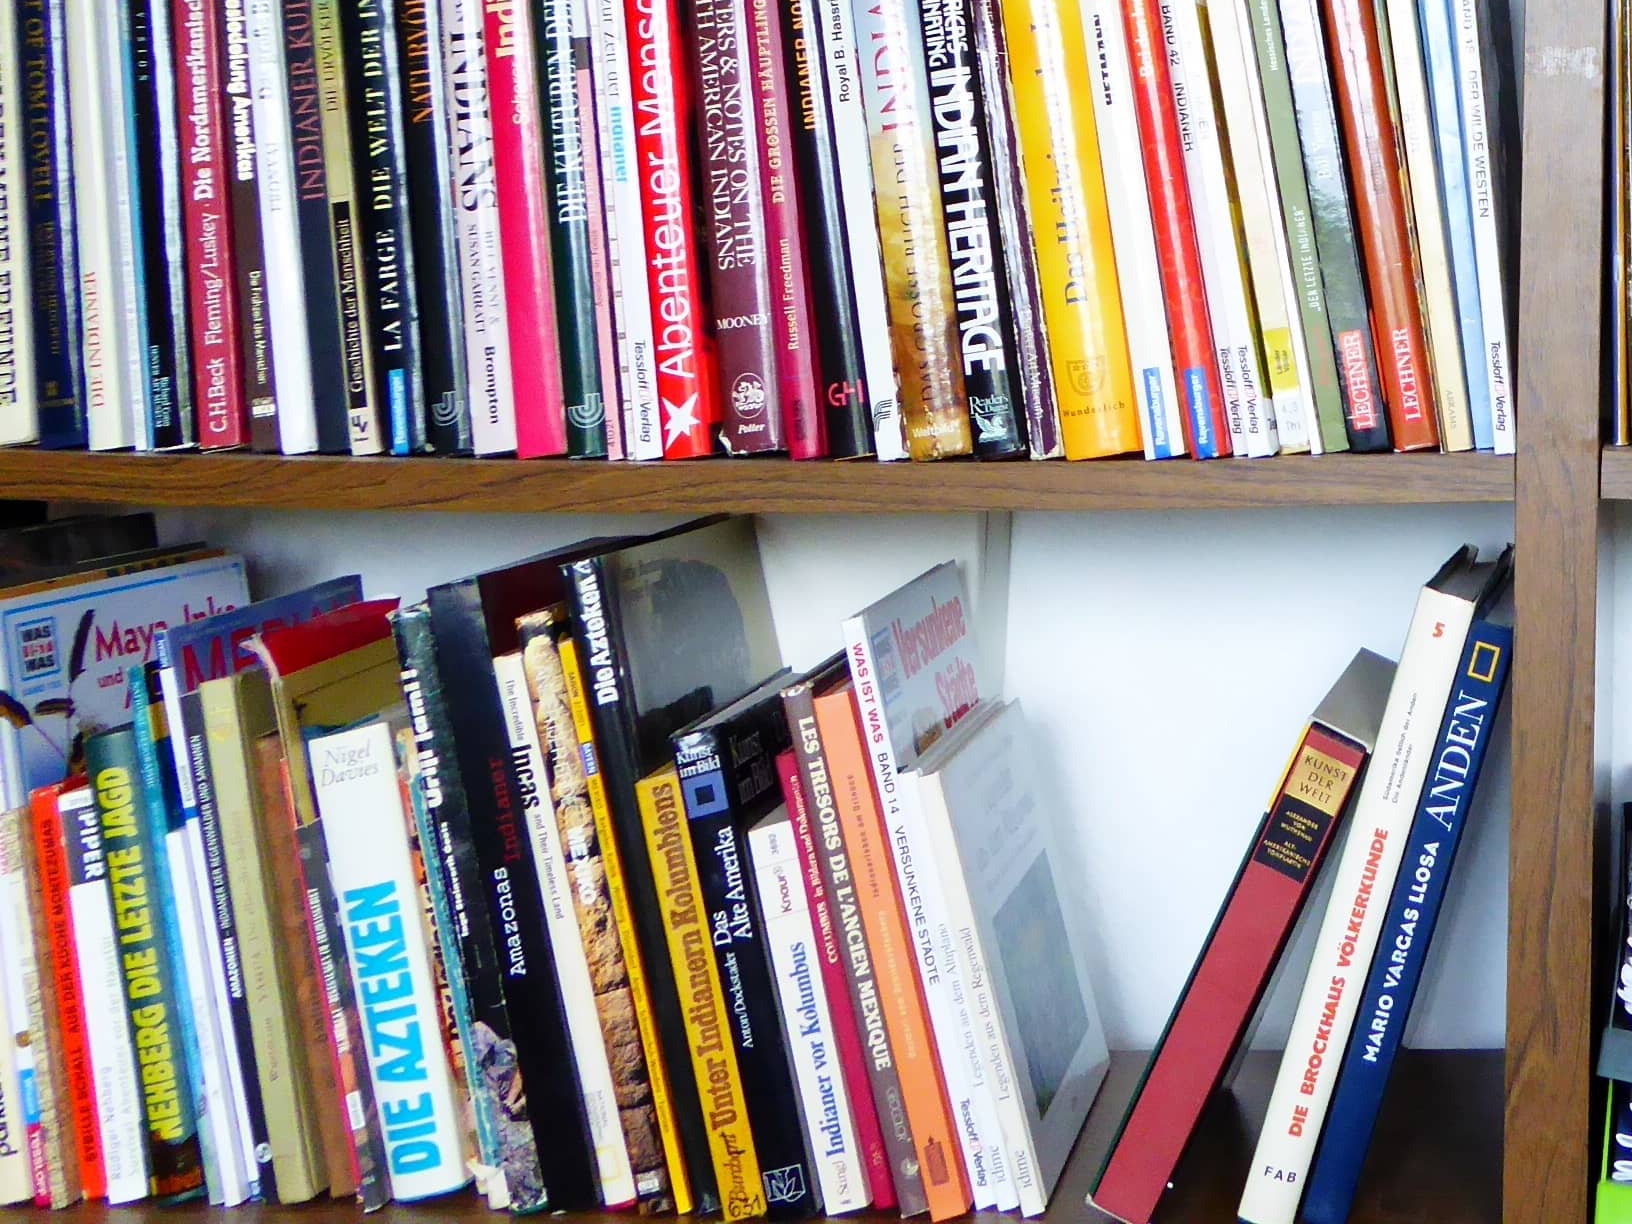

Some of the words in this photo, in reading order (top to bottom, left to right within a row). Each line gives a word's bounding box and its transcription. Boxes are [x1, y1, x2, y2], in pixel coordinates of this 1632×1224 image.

[361, 28, 380, 79] DER
[833, 45, 847, 59] B.
[837, 64, 851, 103] Royal
[288, 59, 327, 201] INDIANER
[364, 88, 387, 159] WELT
[763, 96, 781, 169] GROSSEN
[194, 167, 214, 201] Die
[372, 166, 391, 211] DIE
[771, 174, 786, 204] DIE
[197, 212, 224, 346] Fleming/Luskey
[648, 154, 696, 380] Abenteuer
[778, 238, 795, 302] Freedman
[783, 305, 799, 350] Russell
[206, 357, 226, 433] C.H.Beck
[1344, 332, 1375, 429] LECHNER
[1392, 328, 1422, 420] LECHNER
[581, 575, 615, 667] Azteken
[595, 669, 620, 704] Die
[851, 643, 868, 674] WAS
[859, 676, 872, 701] IST
[865, 706, 884, 743] WAS
[878, 752, 895, 793] BAND
[1425, 690, 1487, 830] ANDEN
[96, 767, 134, 838] JAGD
[888, 798, 899, 814] 14
[75, 814, 108, 878] PIPER
[715, 826, 748, 901] Amerika
[105, 844, 154, 943] LETZTE
[492, 867, 527, 976] Amazonas
[730, 904, 753, 940] Alte
[713, 911, 732, 947] Das
[960, 927, 985, 989] Regenwald
[1363, 995, 1393, 1062] MARIO
[1383, 908, 1418, 988] VARGAS
[1407, 841, 1440, 903] LLOSA
[128, 950, 160, 996] DIE
[343, 880, 427, 1083] AZTEKEN
[786, 942, 821, 1035] Kolumbus
[976, 992, 992, 1017] dem
[1288, 1106, 1308, 1138] DIE
[1300, 975, 1345, 1096] BROCKHAUS
[1336, 828, 1389, 968] VÖLKERKUNDE
[132, 1006, 184, 1138] NEHBERG
[809, 1041, 826, 1070] vor
[990, 1043, 1010, 1101] Legenden
[387, 1087, 442, 1175] DIE
[808, 1074, 845, 1157] Indianer
